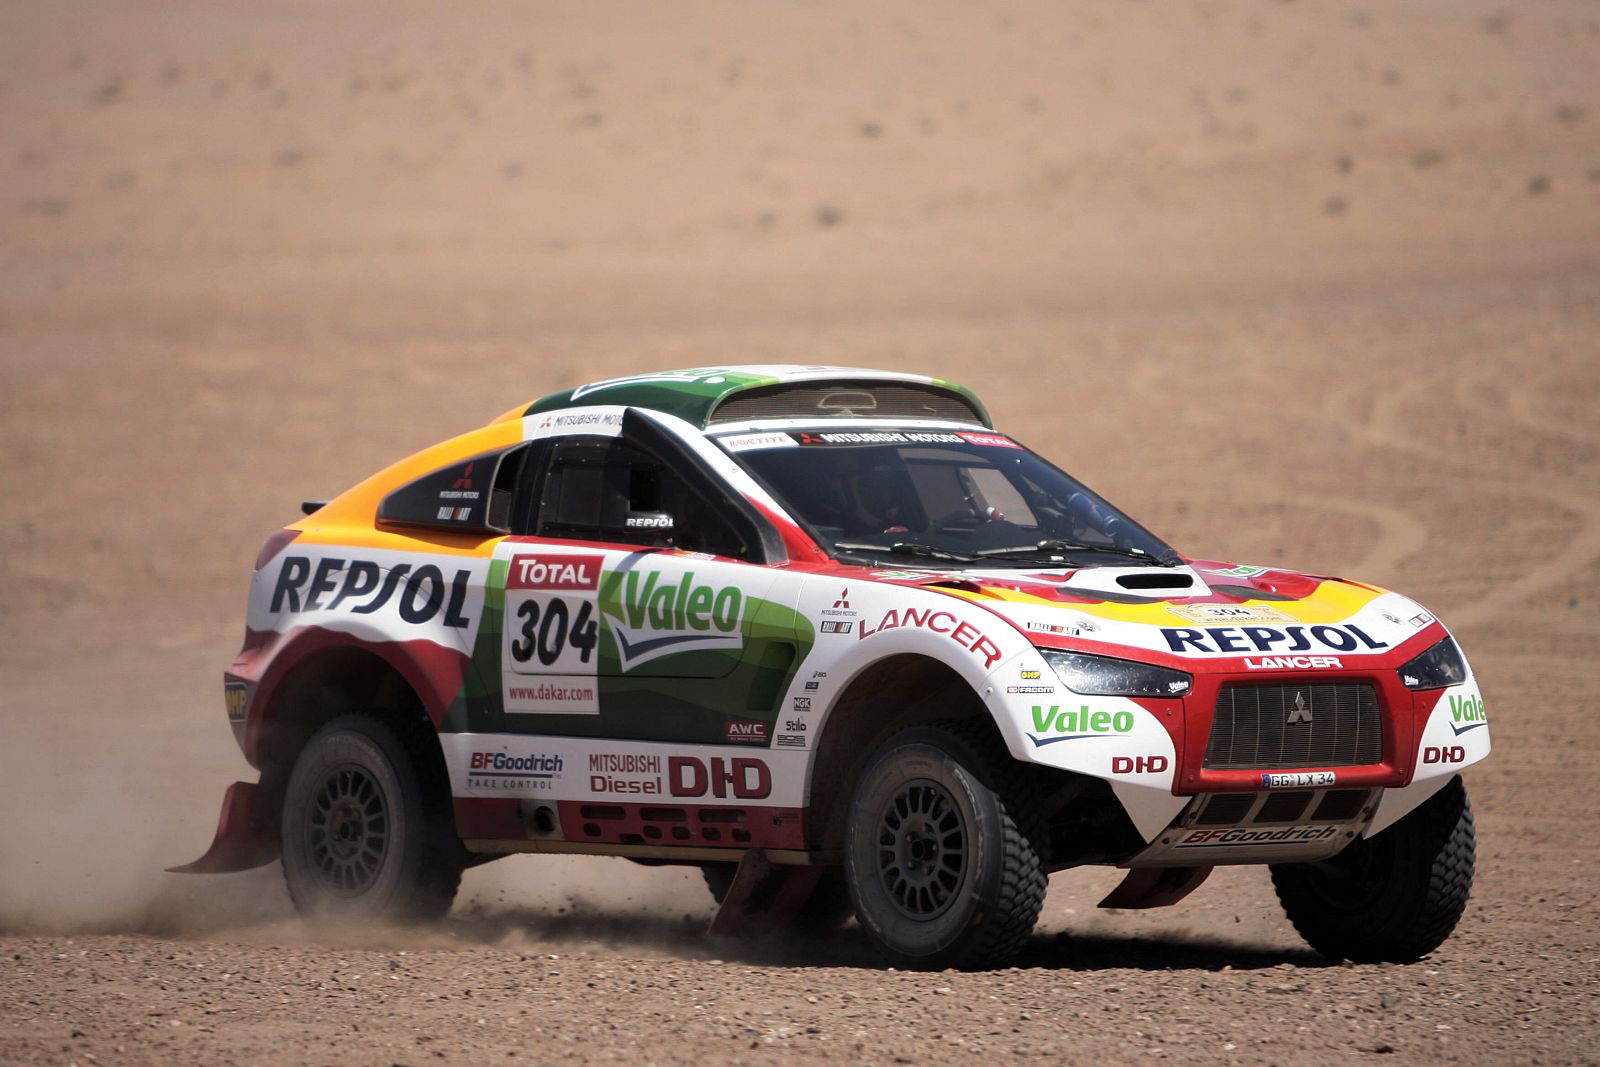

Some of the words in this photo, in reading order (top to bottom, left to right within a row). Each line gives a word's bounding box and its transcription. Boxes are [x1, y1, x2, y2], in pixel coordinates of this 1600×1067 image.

[729, 436, 786, 448] LOCTITE
[820, 432, 905, 443] MITSUBISHI
[903, 433, 965, 444] MOTORS
[962, 435, 1019, 448] TOTAL
[626, 518, 674, 527] REPSOL
[518, 559, 592, 584] TOTAL
[269, 556, 472, 629] REPSOL
[625, 570, 743, 633] Valeo
[1207, 608, 1251, 616] 304
[511, 597, 598, 666] 304
[859, 607, 1003, 670] LANCER
[1160, 624, 1390, 652] REPSOL
[1243, 656, 1344, 669] LANCER
[509, 684, 593, 701] www.dakar.com
[1168, 681, 1189, 692] Valeo
[794, 697, 811, 709] NGK
[786, 717, 807, 731] Stilo
[1032, 705, 1134, 732] Valeo
[729, 723, 764, 735] AWC
[470, 752, 563, 772] BFGoodrich
[589, 754, 660, 773] MITSUBISHI
[467, 778, 497, 789] TAKE
[503, 779, 552, 790] CONTROL
[590, 775, 663, 795] Diesel
[1271, 775, 1289, 787] GG
[1297, 774, 1314, 786] LX
[1317, 773, 1335, 785] 34
[1181, 825, 1338, 844] BFGoodrich
